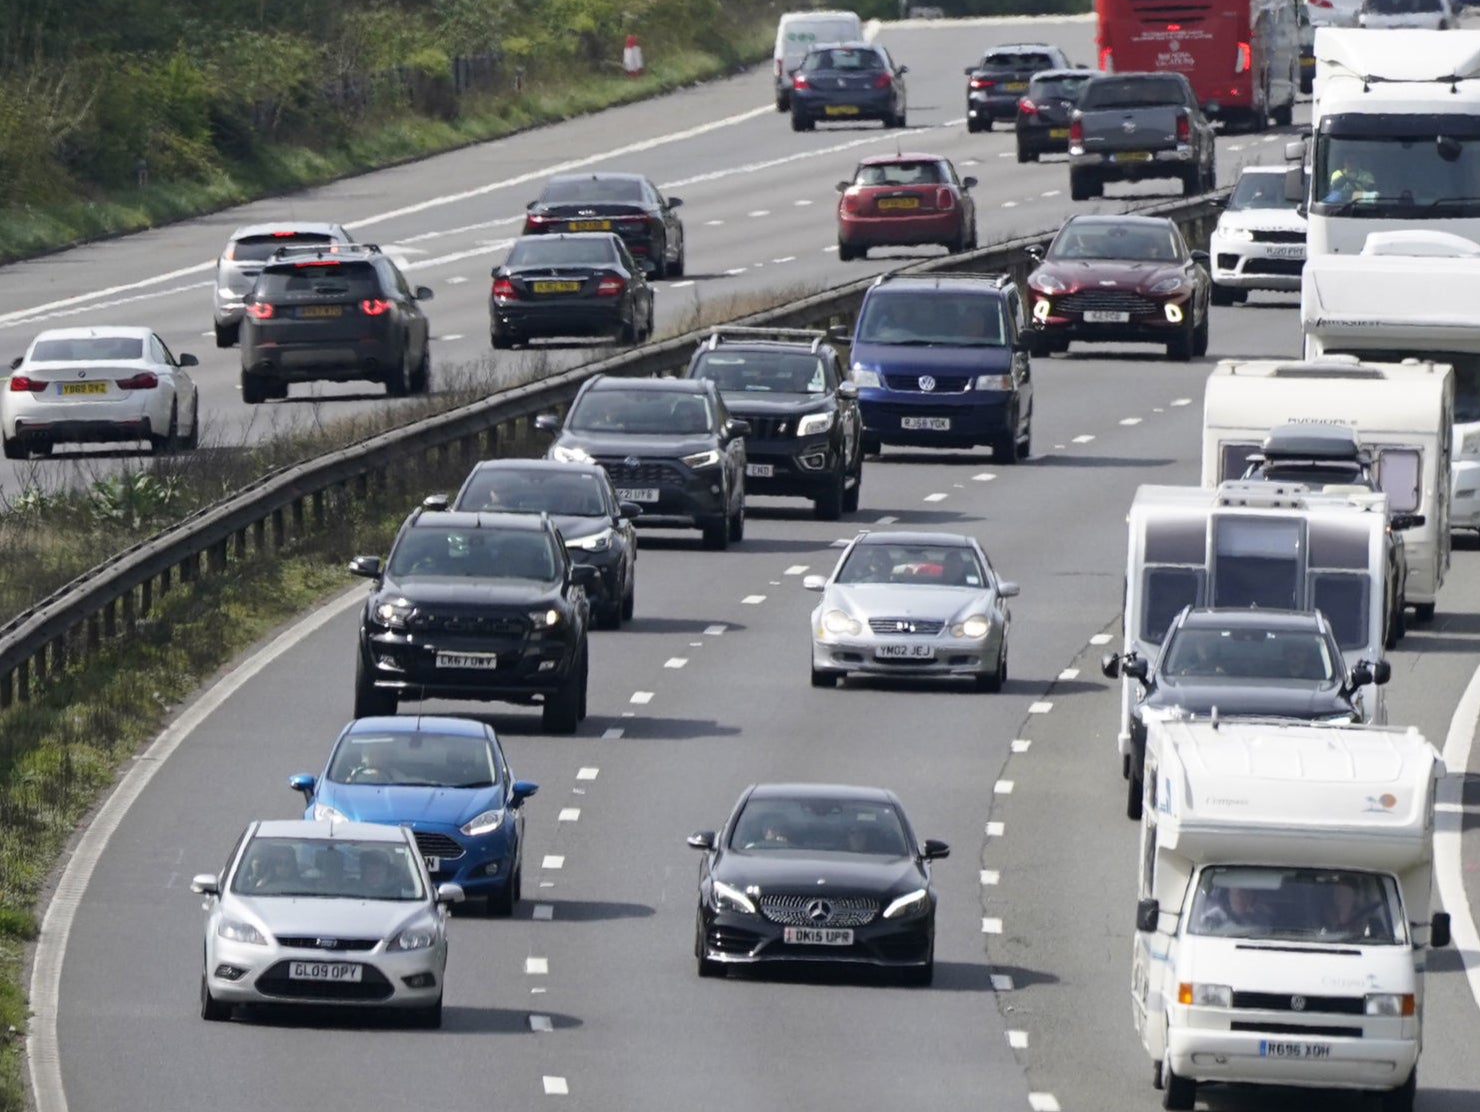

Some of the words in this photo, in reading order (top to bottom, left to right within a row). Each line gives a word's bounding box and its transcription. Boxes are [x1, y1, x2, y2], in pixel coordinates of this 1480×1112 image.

[880, 645, 908, 656] YM02
[910, 645, 931, 657] JEJ
[795, 929, 823, 943] DK15
[825, 930, 850, 944] UPR
[294, 963, 328, 978] GL09
[331, 964, 358, 979] OPY
